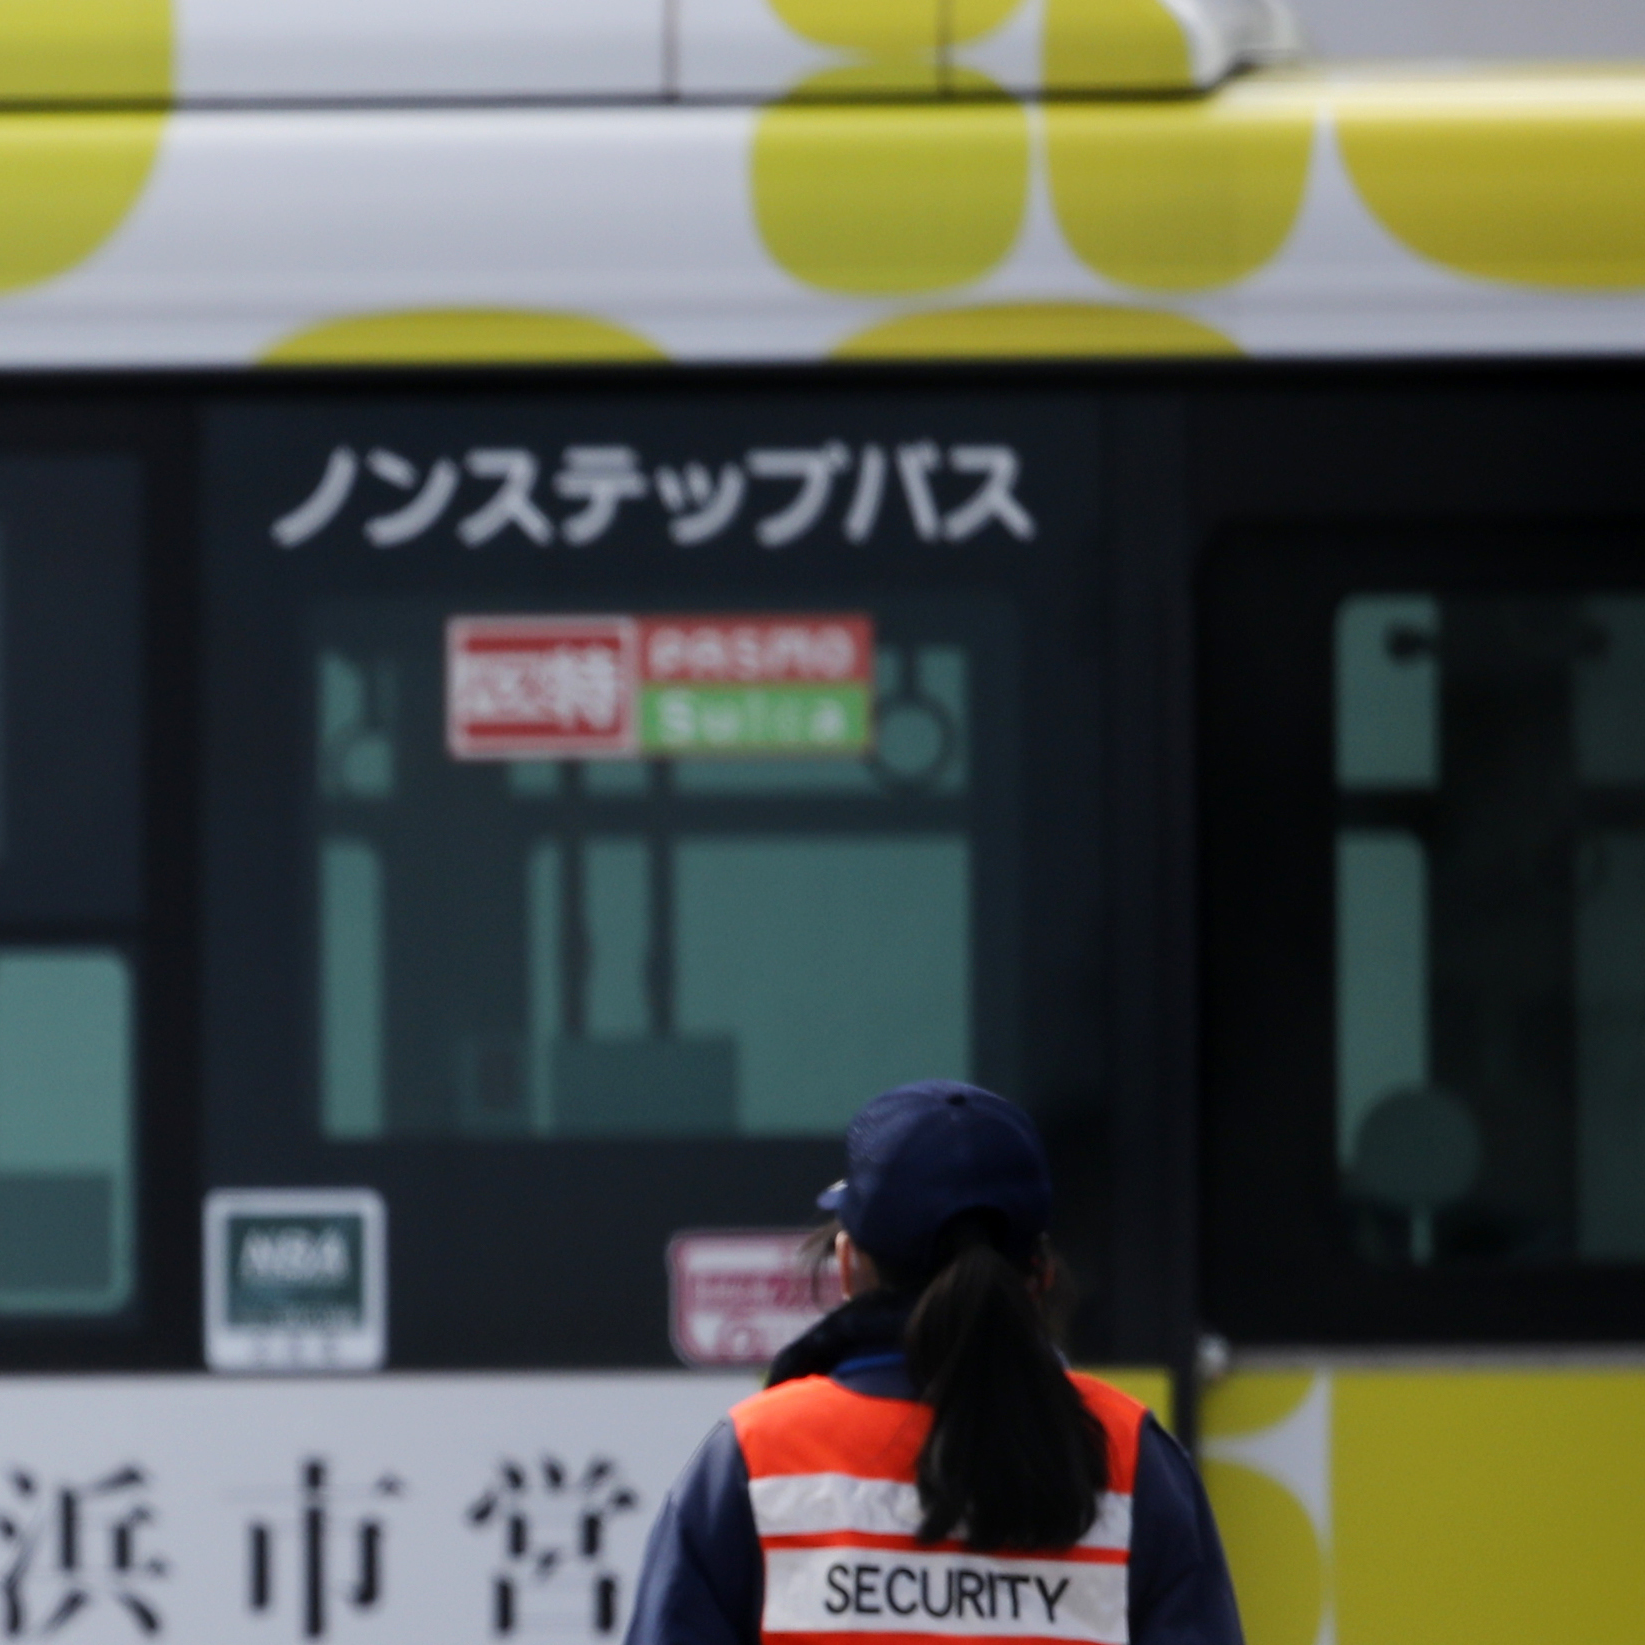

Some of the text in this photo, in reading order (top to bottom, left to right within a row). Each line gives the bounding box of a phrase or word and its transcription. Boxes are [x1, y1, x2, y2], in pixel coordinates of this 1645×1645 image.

[270, 442, 1037, 549] ノンステップバス
[646, 627, 858, 680] PASMO
[657, 691, 848, 746] Suica
[823, 1563, 1071, 1624] SECURITY
